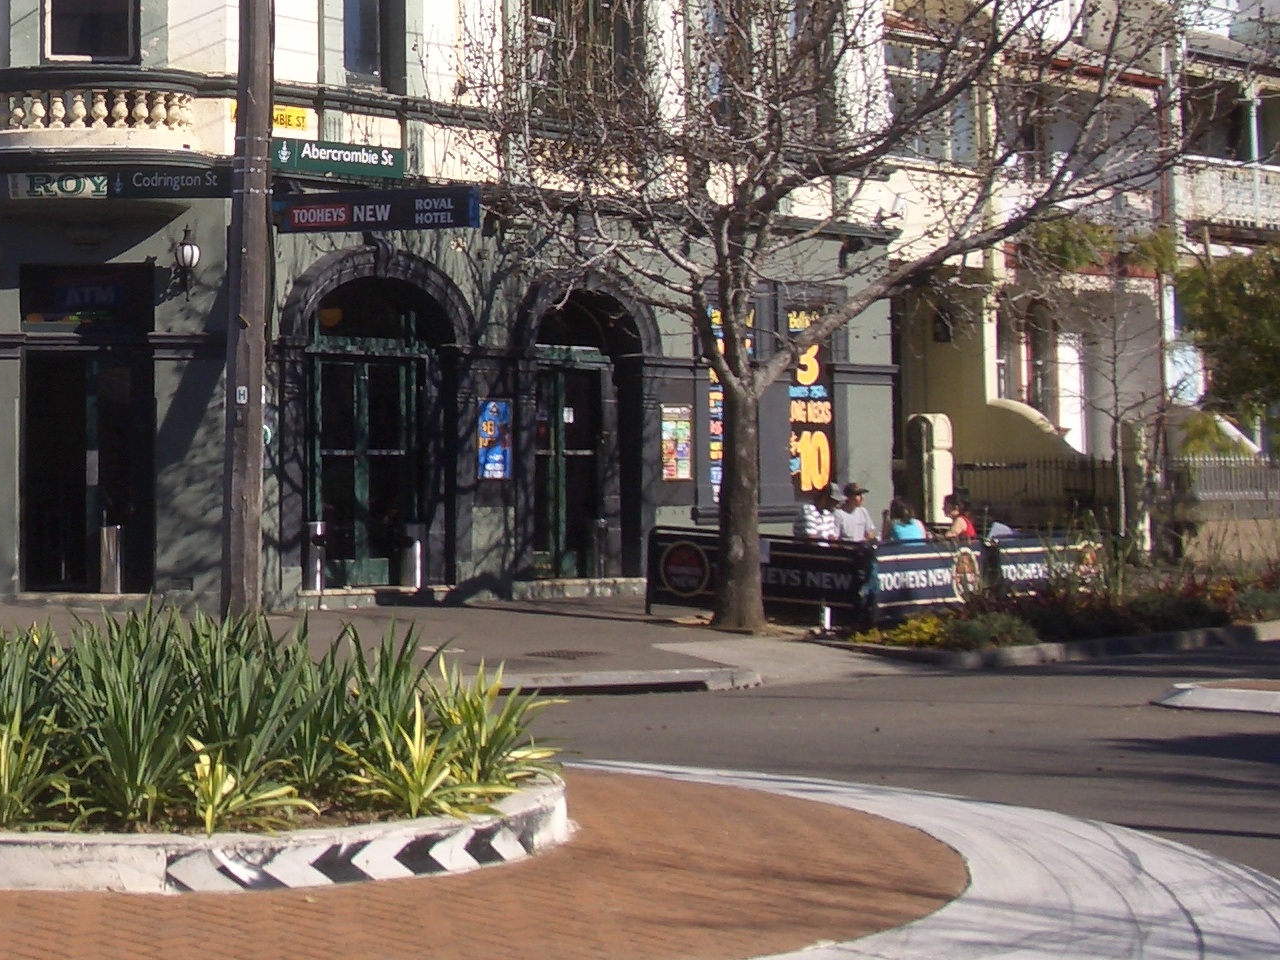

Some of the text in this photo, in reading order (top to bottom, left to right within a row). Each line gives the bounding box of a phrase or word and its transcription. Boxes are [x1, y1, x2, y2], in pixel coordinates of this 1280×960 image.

[300, 143, 394, 166] Abercrombie St
[132, 171, 218, 191] Codrington St
[292, 204, 391, 224] TOOHEYS NEW
[415, 197, 454, 211] ROYAL
[415, 211, 454, 224] HOTEL
[805, 569, 854, 590] NEW
[878, 566, 952, 591] TOOHEYS NEW
